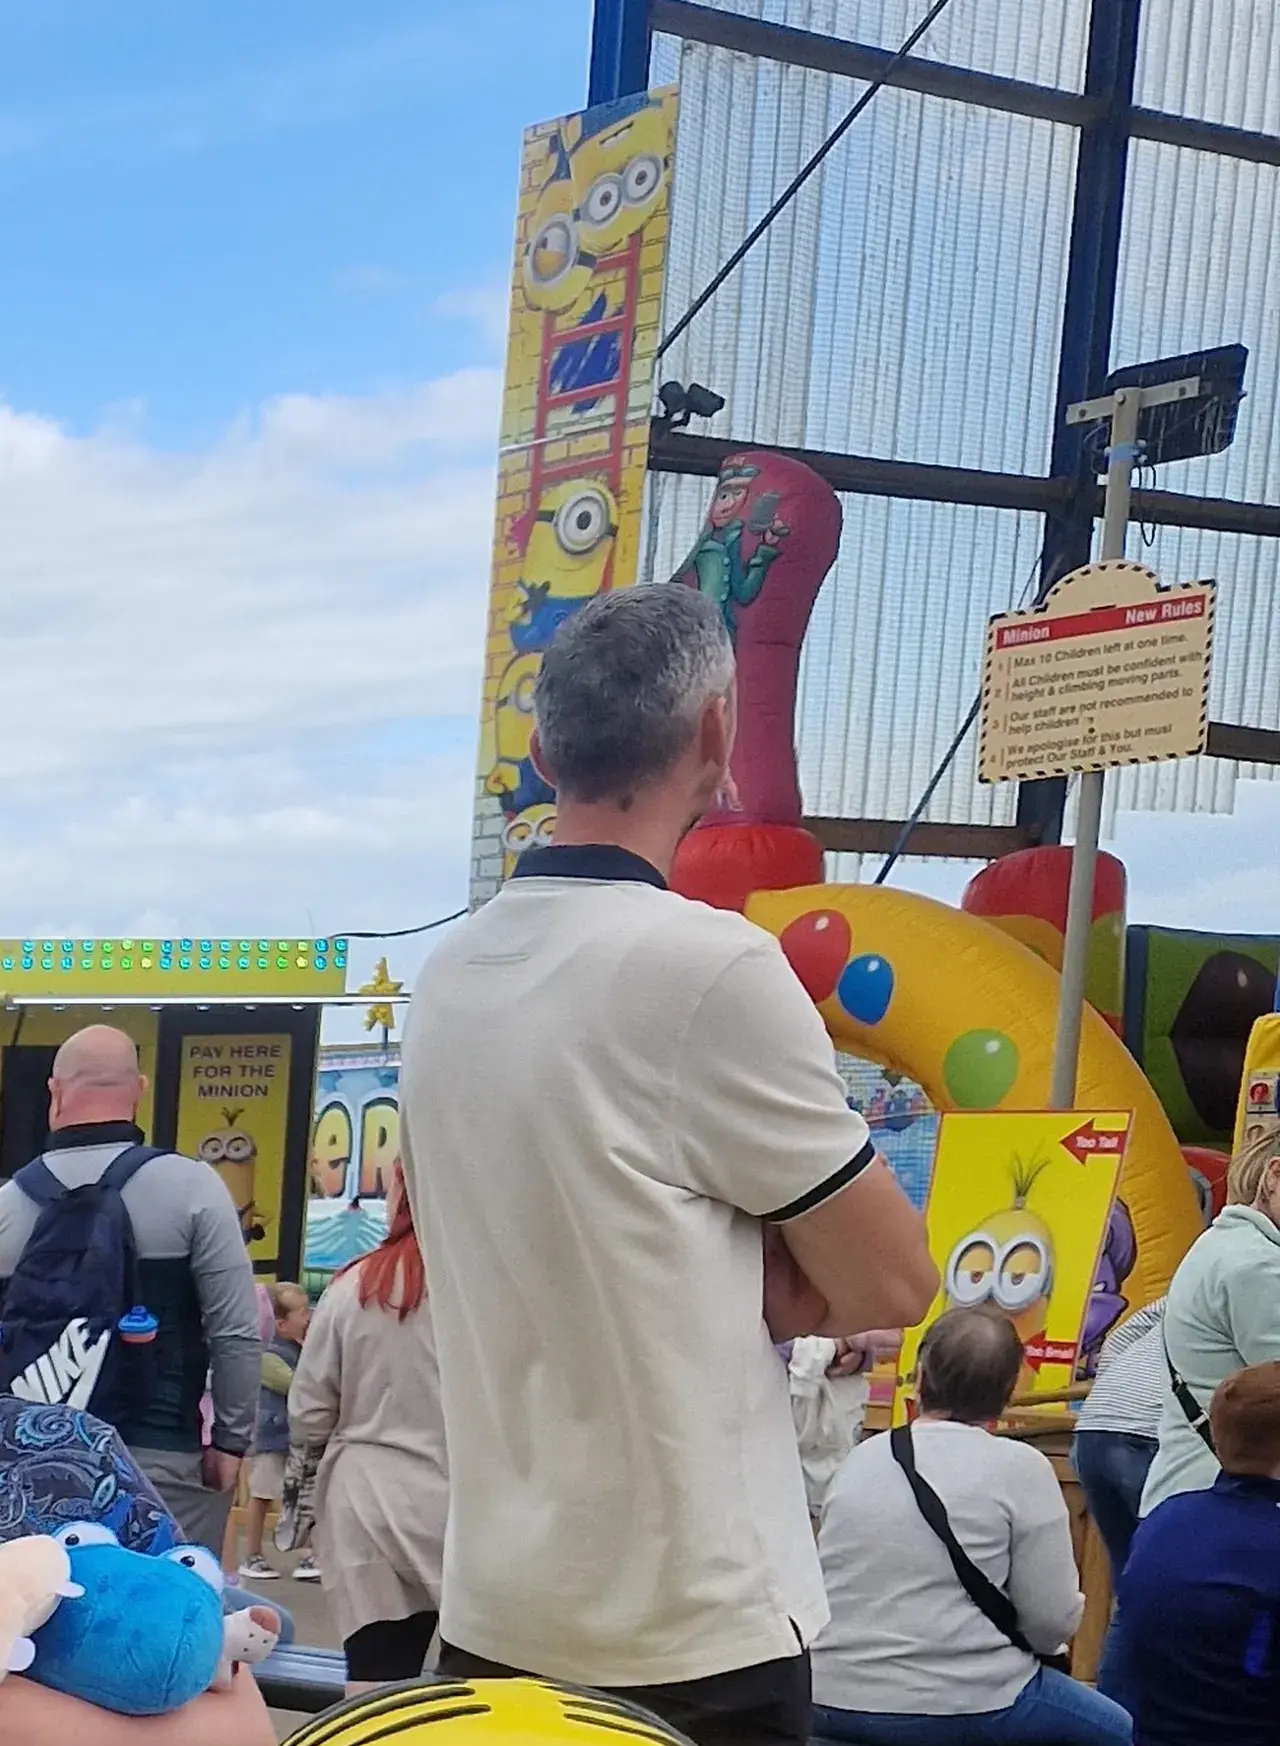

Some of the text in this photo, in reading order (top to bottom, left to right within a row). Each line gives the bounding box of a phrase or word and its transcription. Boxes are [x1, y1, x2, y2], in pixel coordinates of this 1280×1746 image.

[1003, 600, 1202, 645] Minion New Rules
[1041, 653, 1052, 664] 10
[1055, 647, 1101, 662] Children
[1104, 642, 1121, 654] left
[1124, 641, 1134, 652] at
[1137, 639, 1158, 649] one
[1012, 678, 1026, 689] All
[1029, 672, 1075, 686] Children
[1077, 665, 1104, 678] must
[1107, 664, 1121, 675] be
[1123, 655, 1176, 672] confident
[1179, 651, 1203, 664] with
[1012, 688, 1045, 702] height
[1047, 686, 1055, 696] &
[1058, 680, 1105, 694] climbing
[1108, 673, 1148, 687] moving
[1010, 711, 1030, 722] Our
[1033, 706, 1057, 719] staff
[1059, 705, 1076, 715] are
[1079, 701, 1097, 712] not
[1100, 688, 1179, 709] recommended
[1182, 687, 1193, 697] to
[1007, 745, 1024, 755] We
[1027, 739, 1079, 754] apologise
[1083, 734, 1098, 745] for
[1100, 731, 1120, 742] this
[1123, 728, 1142, 739] but
[1144, 724, 1173, 736] must
[1009, 718, 1079, 736] help children
[1005, 754, 1045, 770] protect
[1047, 752, 1068, 763] Our
[1070, 747, 1096, 761] Staff
[1098, 745, 1106, 755] &
[190, 1045, 282, 1059] PAY HERE
[193, 1064, 276, 1079] FOR THE
[198, 1084, 268, 1098] MINION
[1075, 1135, 1097, 1149] Too
[10, 1317, 95, 1404] NIKE
